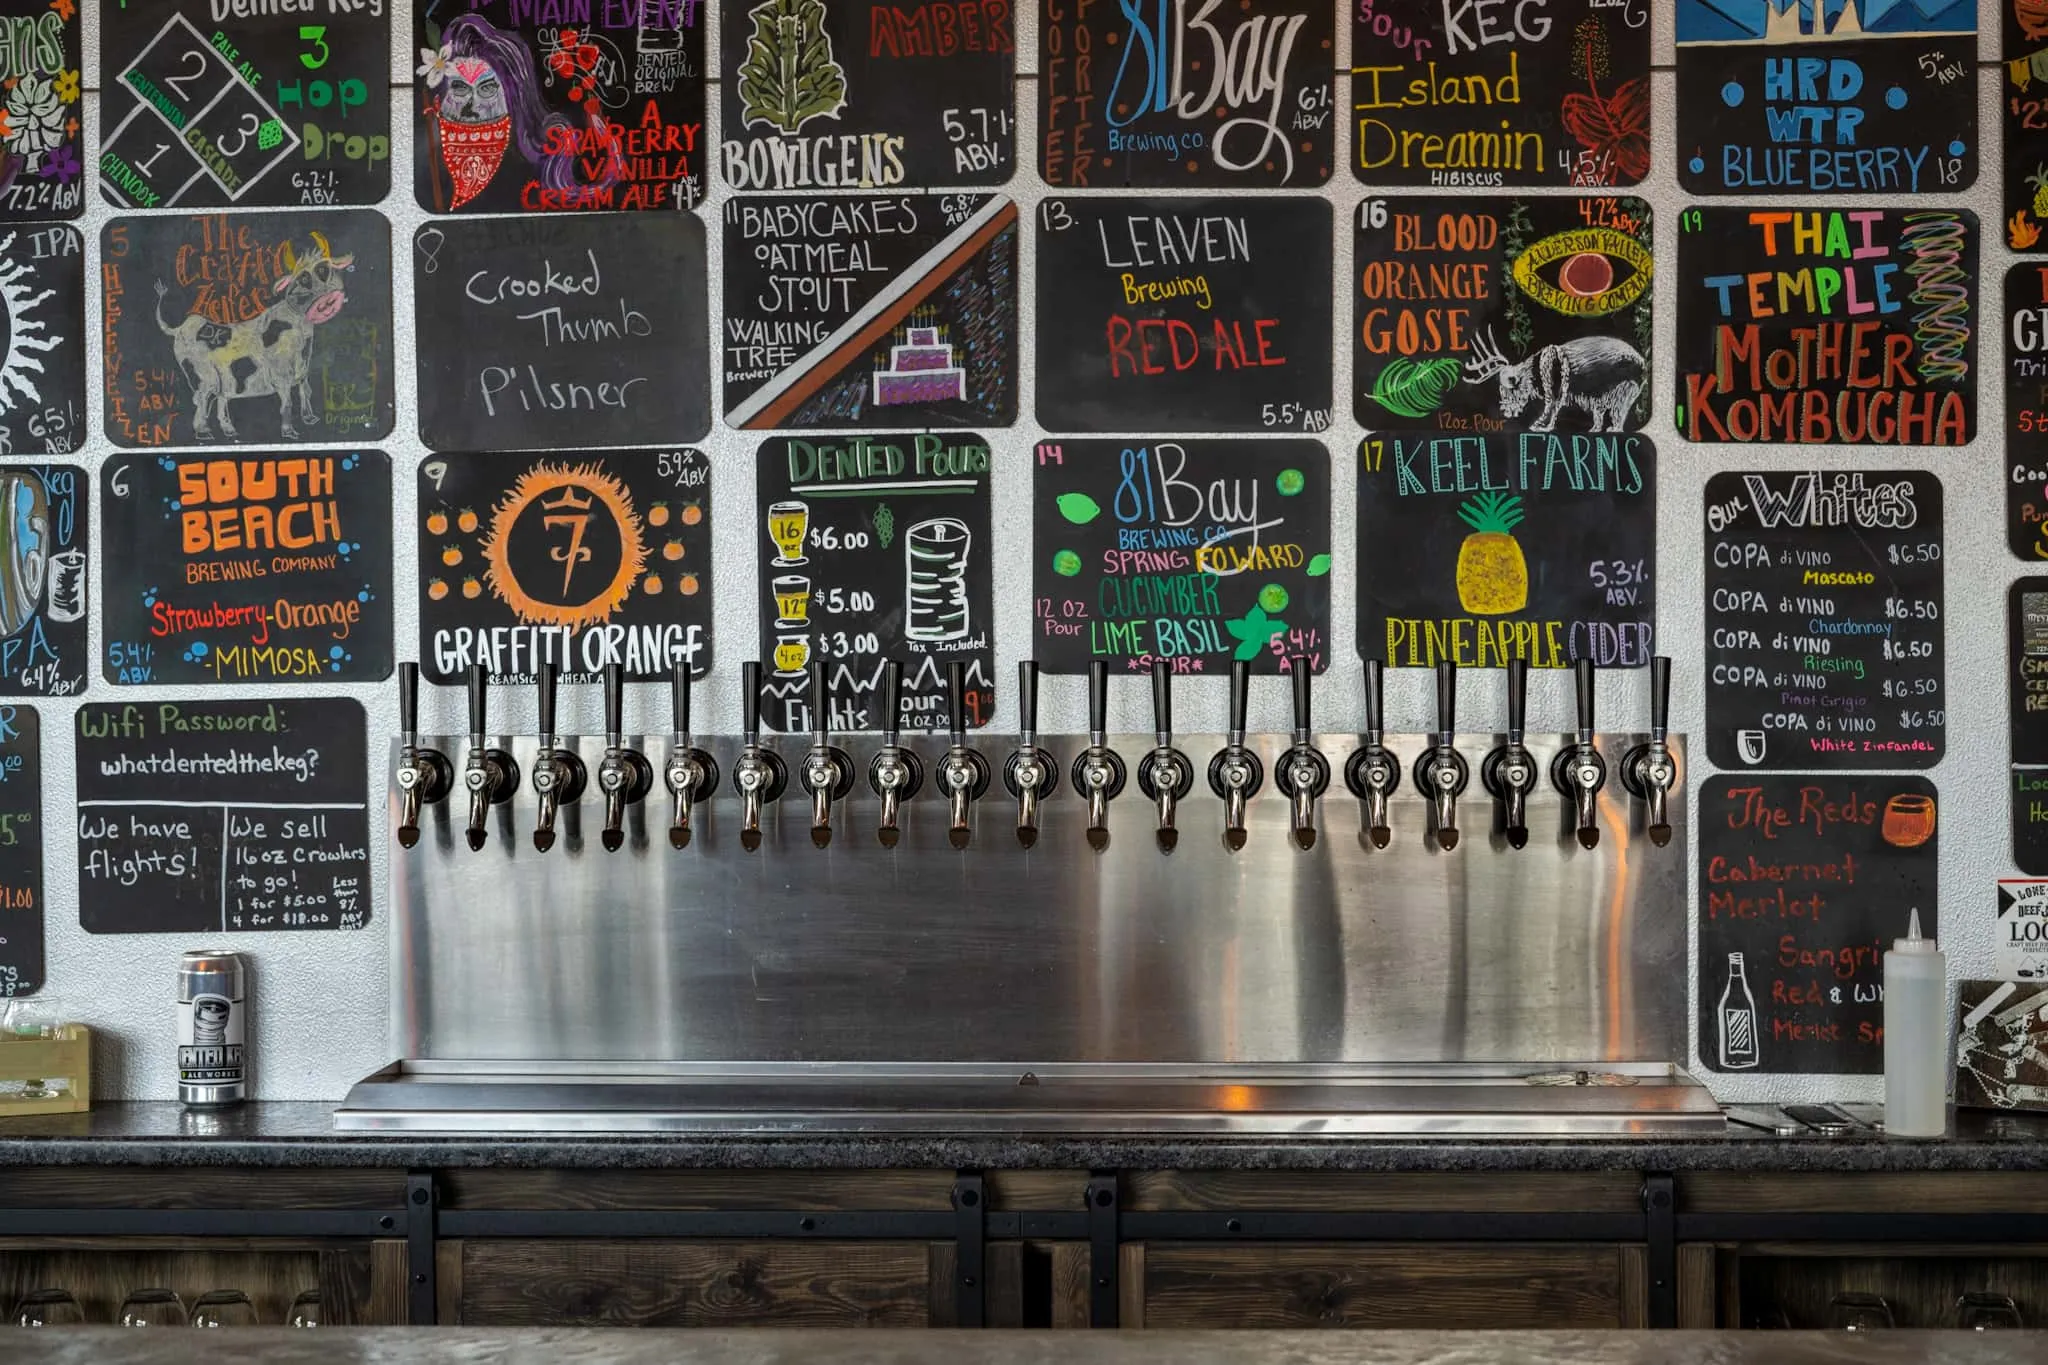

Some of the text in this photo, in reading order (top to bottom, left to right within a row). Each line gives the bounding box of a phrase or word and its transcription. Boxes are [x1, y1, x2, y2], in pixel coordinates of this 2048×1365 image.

[869, 0, 1015, 58] AMBER
[1442, 0, 1553, 55] KEG
[211, 31, 262, 90] PALE ALE
[300, 26, 330, 69] 3
[636, 52, 688, 68] DENTED
[164, 51, 207, 102] 2
[635, 80, 675, 94] BREW
[1351, 51, 1521, 110] Island
[1765, 57, 1864, 102] HRD
[640, 98, 663, 130] A
[1292, 110, 1330, 131] ABV
[1766, 105, 1865, 145] WTR
[217, 113, 260, 157] 3
[303, 123, 388, 172] Drop
[1108, 129, 1181, 161] Brewing
[1359, 118, 1545, 173] Dreamin
[134, 143, 171, 178] 1
[185, 128, 243, 193] CASCADE
[582, 155, 689, 182] VANILLA
[1722, 144, 1929, 193] BLUEBERRY
[1937, 157, 1963, 186] 18
[100, 152, 161, 208] CHINOOK
[520, 178, 668, 210] CREAM ALE
[1431, 171, 1504, 187] HIBISCUS
[8, 182, 51, 211] 7.2%
[743, 198, 918, 239] BABYCAKES
[1361, 200, 1388, 229] 16
[1683, 210, 1702, 233] 19
[28, 226, 81, 260] IPA
[112, 227, 129, 257] 5
[192, 213, 253, 252] The
[1098, 215, 1251, 268] LEAVEN
[1394, 213, 1498, 252] BLOOD
[1750, 211, 1890, 260] THAI
[417, 228, 445, 273] 8
[755, 240, 888, 273] OATMEAL
[465, 248, 601, 305] Crooked
[1120, 272, 1212, 310] Brewing
[1363, 261, 1490, 300] ORANGE
[1704, 263, 1902, 319] TEMPLE
[758, 274, 857, 313] STOUT
[516, 297, 651, 347] Thumb
[727, 318, 830, 347] WALKING
[1363, 307, 1471, 356] GOSE
[727, 345, 797, 369] TREE
[1106, 313, 1286, 378] RED ALE
[480, 364, 649, 416] Pilsner
[726, 367, 778, 384] Brewery
[1473, 413, 1505, 432] Pour
[788, 436, 905, 483] DENTED
[1037, 445, 1063, 466] 14
[1363, 440, 1384, 473] 17
[1393, 433, 1644, 496] KEEL FARMS
[111, 464, 130, 498] 6
[178, 458, 335, 507] SOUTH
[424, 461, 448, 491] 9
[1743, 470, 1918, 530] Whites
[181, 501, 342, 554] BEACH
[778, 520, 801, 540] 16
[810, 526, 869, 551] $6.00
[1118, 526, 1199, 551] BREWING
[186, 554, 337, 585] BREWING COMPANY
[1103, 549, 1190, 575] SPRING
[1713, 542, 1941, 569] COPA di VINO $6.50
[815, 587, 875, 614] $5.00
[1098, 572, 1221, 618] CUCUMBER
[1713, 588, 1939, 620] COPA di VINO $6.50
[1045, 619, 1083, 636] Pour
[1091, 618, 1230, 658] LIME BASIL
[1385, 616, 1653, 669] PINEAPPLE CIDER
[1808, 617, 1893, 640] Chardonnay
[434, 623, 705, 676] GRAFFITI ORANGE
[819, 631, 879, 658] $3.00
[906, 639, 927, 653] Tax
[1713, 628, 1933, 662] COPA di VINO $6.50
[1712, 664, 1938, 699] COPA di VINO $6.50
[1803, 654, 1866, 680] Riesling
[785, 697, 869, 733] Flihts
[1780, 692, 1817, 706] Pinot
[80, 706, 146, 739] Wifi
[899, 713, 910, 728] 4
[1761, 709, 1945, 733] COPA di VINO $6.50
[1809, 736, 1857, 753] White
[100, 745, 320, 782] whatdentedthekeg?
[79, 814, 192, 841] We have
[230, 815, 267, 838] We
[1727, 786, 1878, 839] The Reds
[236, 842, 367, 865] 16 oz Crowlers
[1708, 853, 1861, 885] Cabernet
[236, 874, 257, 890] to
[250, 894, 328, 910] for $5.00
[340, 910, 363, 924] ABV
[1708, 887, 1828, 922] Merlot
[232, 913, 275, 928] 4 for
[1778, 934, 1882, 978] Sangri
[1771, 978, 1824, 1006] Red
[187, 1070, 202, 1079] ALE
